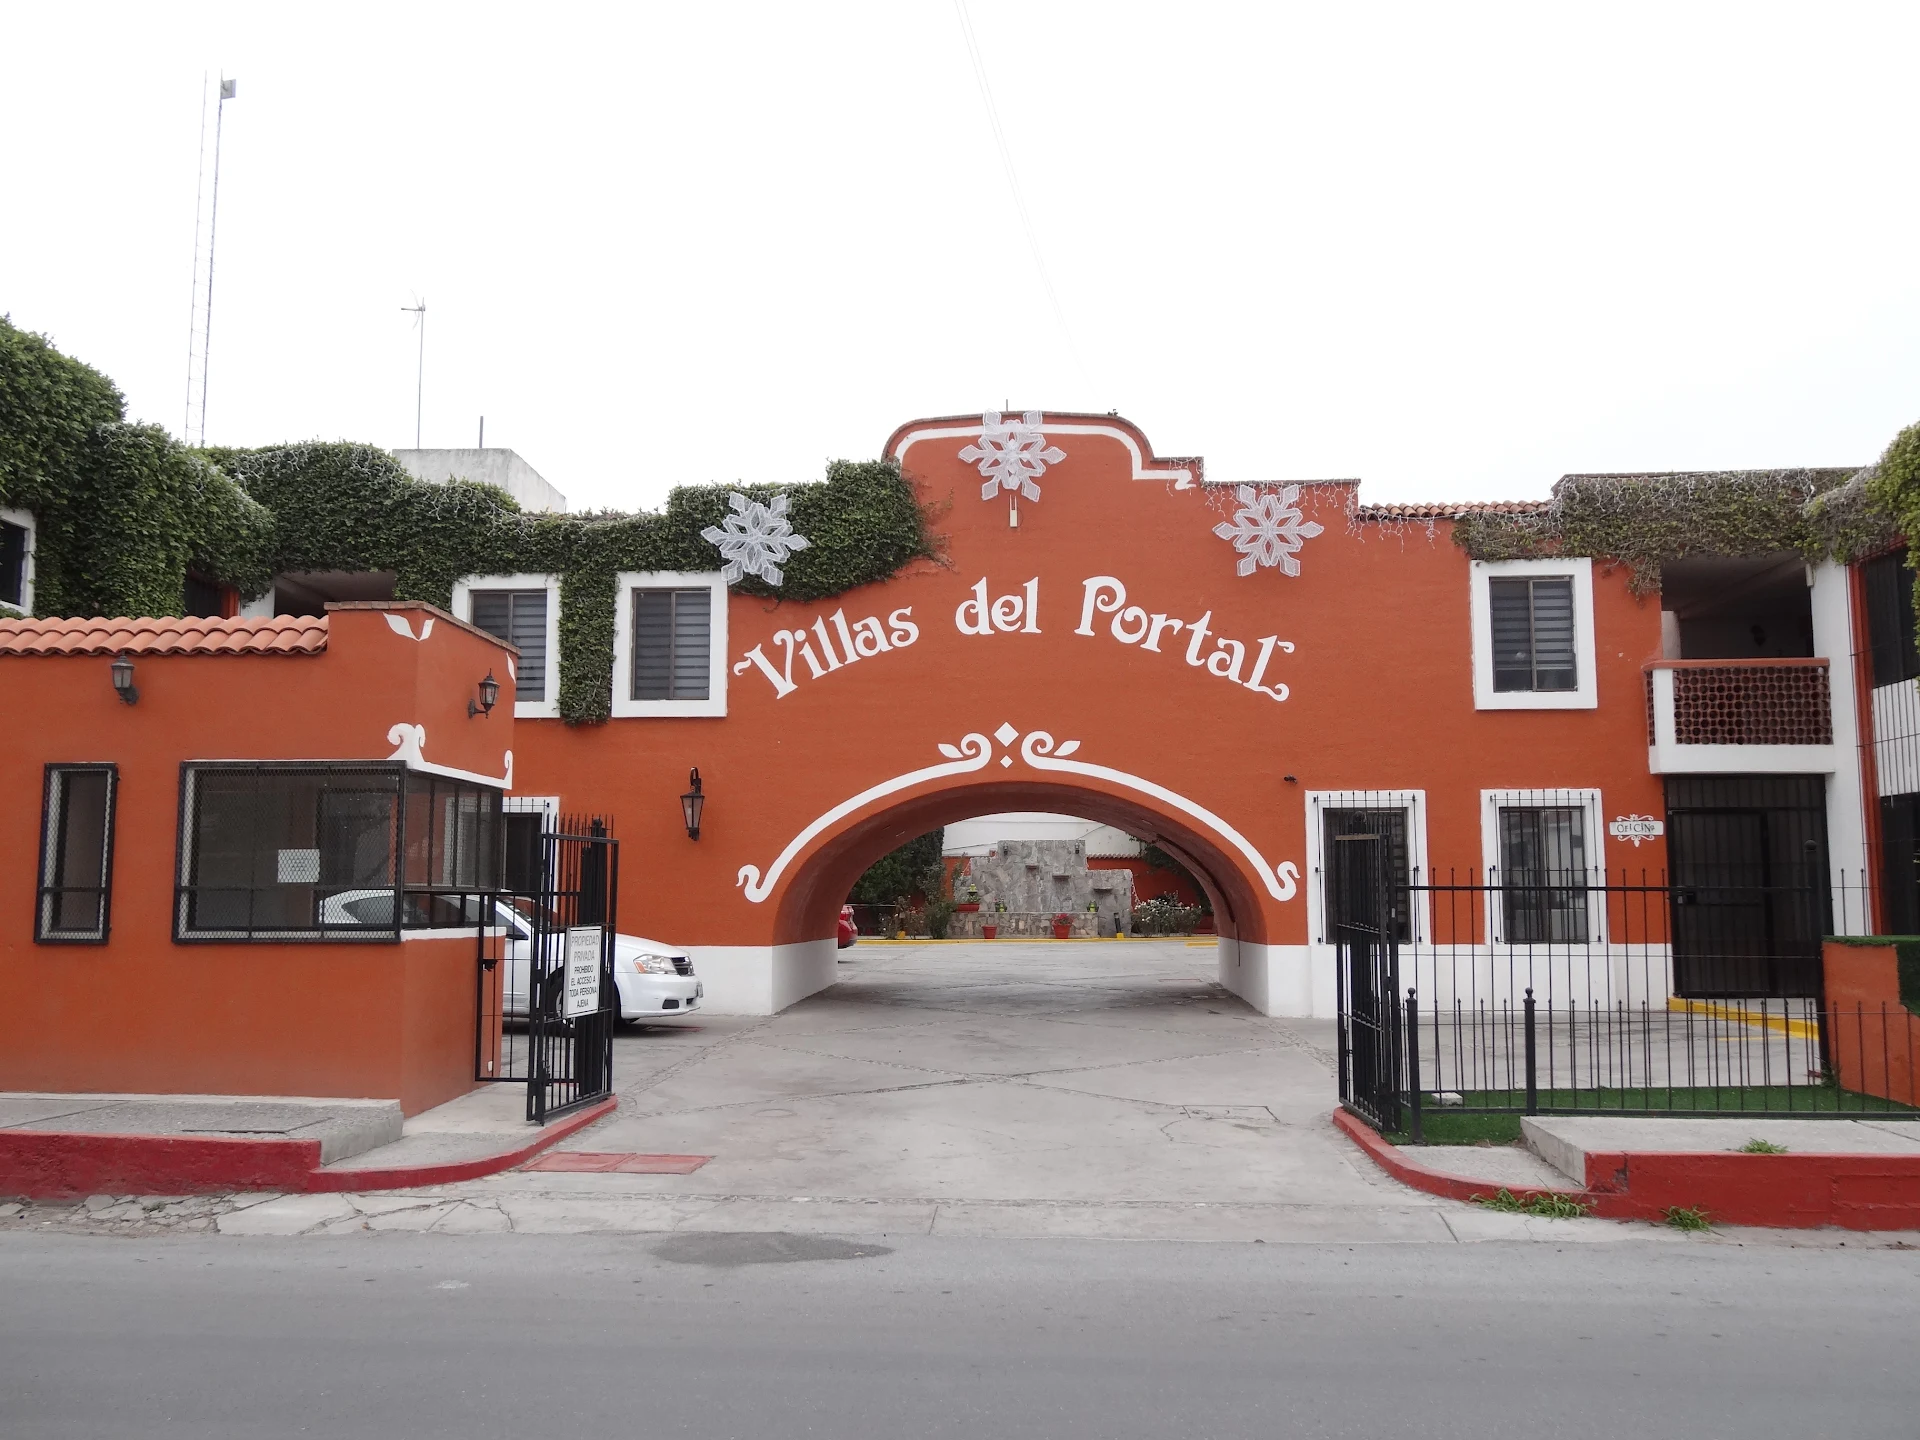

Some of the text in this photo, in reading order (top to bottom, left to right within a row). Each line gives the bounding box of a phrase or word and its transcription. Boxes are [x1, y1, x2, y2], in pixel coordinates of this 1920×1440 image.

[733, 575, 1295, 702] Villas del Portal
[571, 934, 600, 947] PROPIEDAD
[573, 950, 595, 962] PRIVADA
[574, 965, 594, 974] PROHIBIDO
[570, 978, 576, 986] EL
[577, 975, 593, 985] ACCESO
[569, 986, 597, 997] TODA PERSONA
[576, 999, 589, 1008] AJENA
